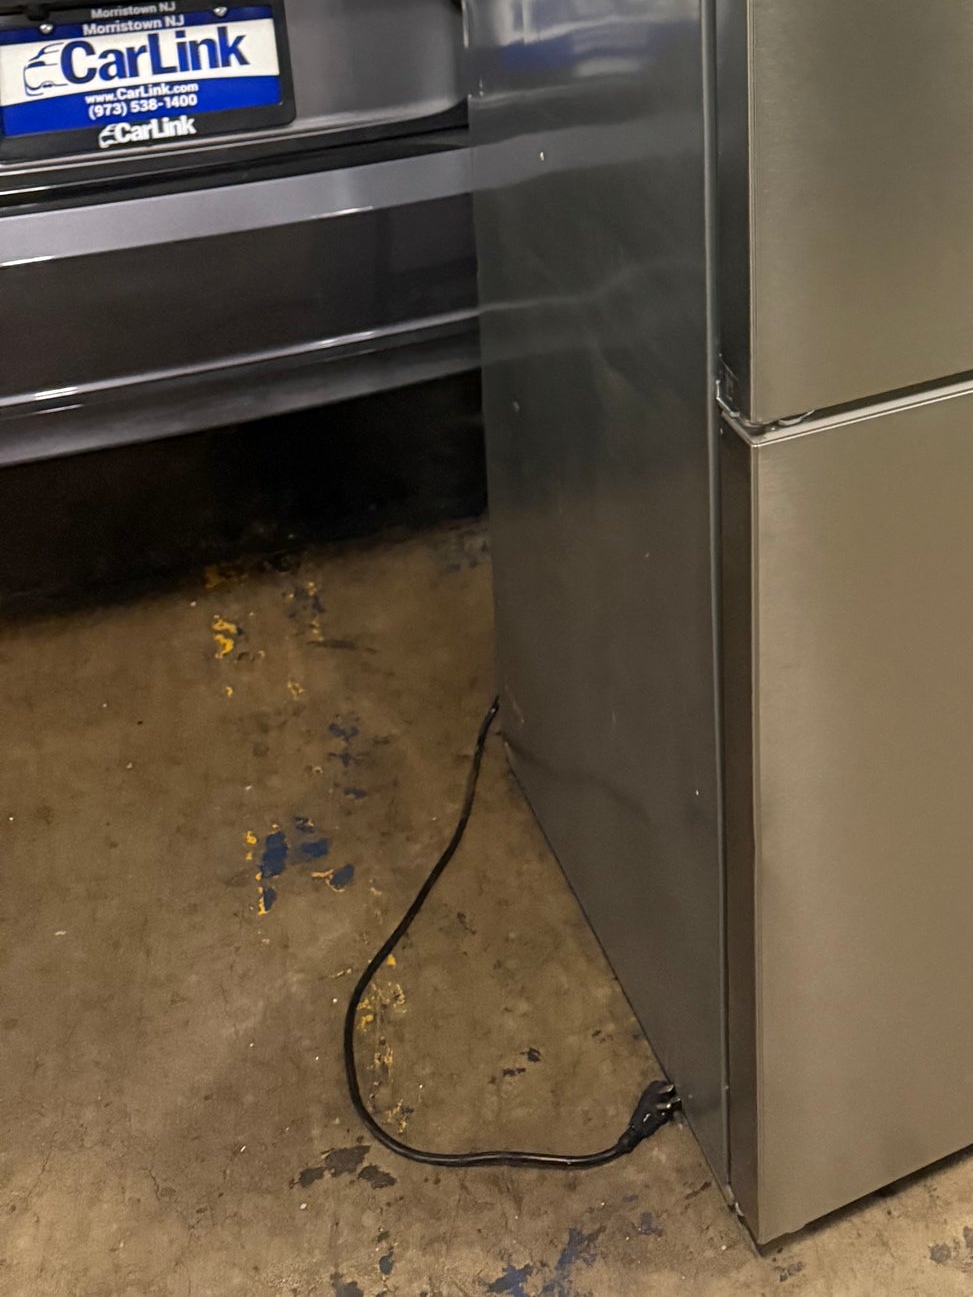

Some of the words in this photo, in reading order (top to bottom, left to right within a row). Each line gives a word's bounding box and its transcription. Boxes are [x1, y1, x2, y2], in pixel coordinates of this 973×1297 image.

[91, 4, 158, 20] Morristown
[158, 1, 176, 12] NJ
[82, 17, 163, 36] Morristown
[164, 14, 185, 28] NJ
[60, 26, 250, 85] CarLink
[84, 82, 199, 105] www.CarLink.com
[88, 102, 128, 121] (973)
[129, 93, 198, 114] 538-1400
[114, 114, 197, 143] CarLink
